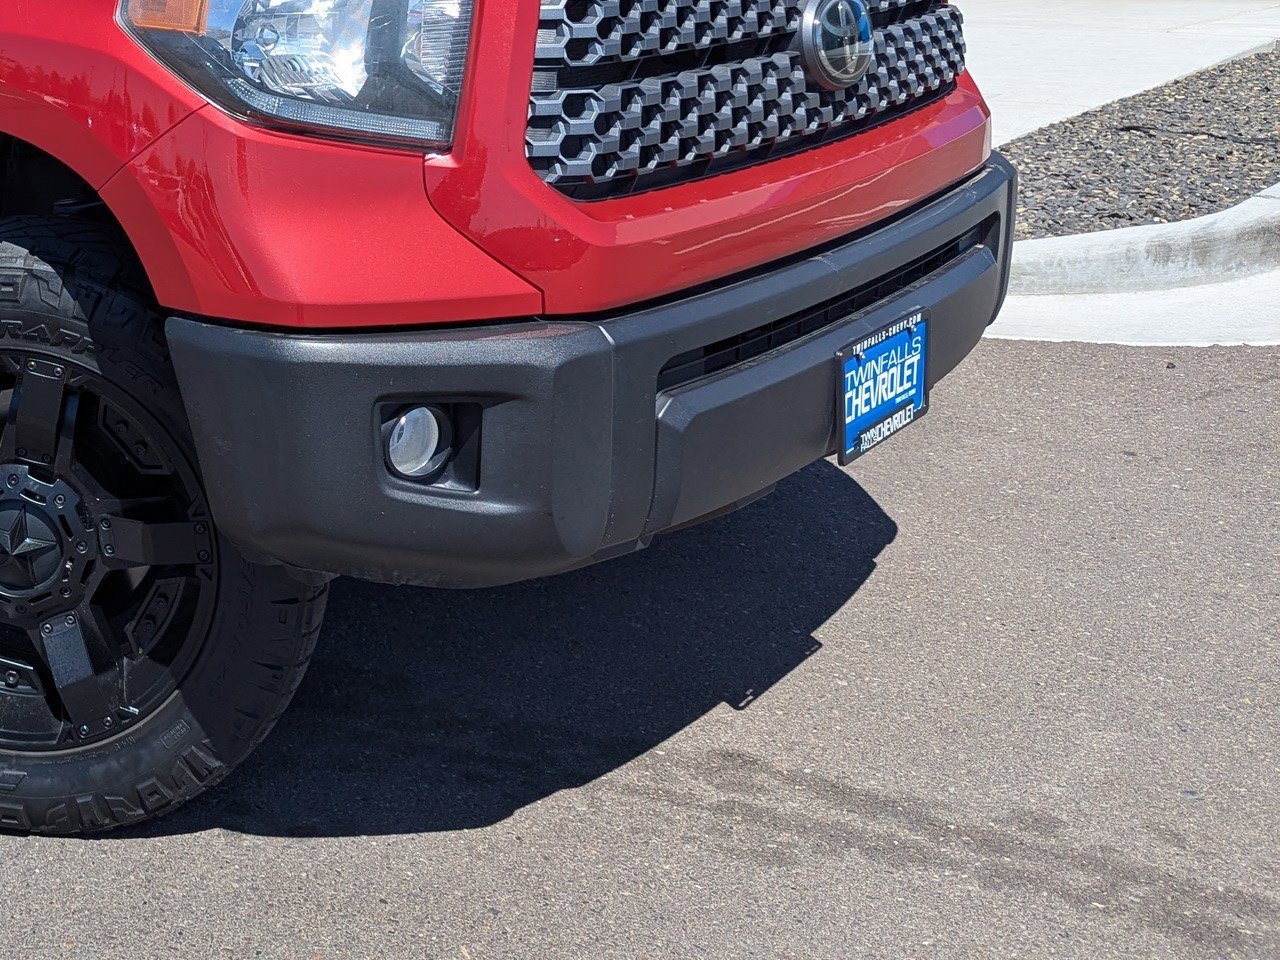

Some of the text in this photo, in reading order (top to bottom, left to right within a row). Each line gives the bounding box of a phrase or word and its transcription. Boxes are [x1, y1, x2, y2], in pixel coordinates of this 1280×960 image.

[852, 313, 922, 355] TWINFALLS-CHEVY.COM
[845, 336, 922, 390] TWINFALLS
[844, 353, 921, 424] CHEVROLET
[875, 403, 915, 441] CHEVROLET
